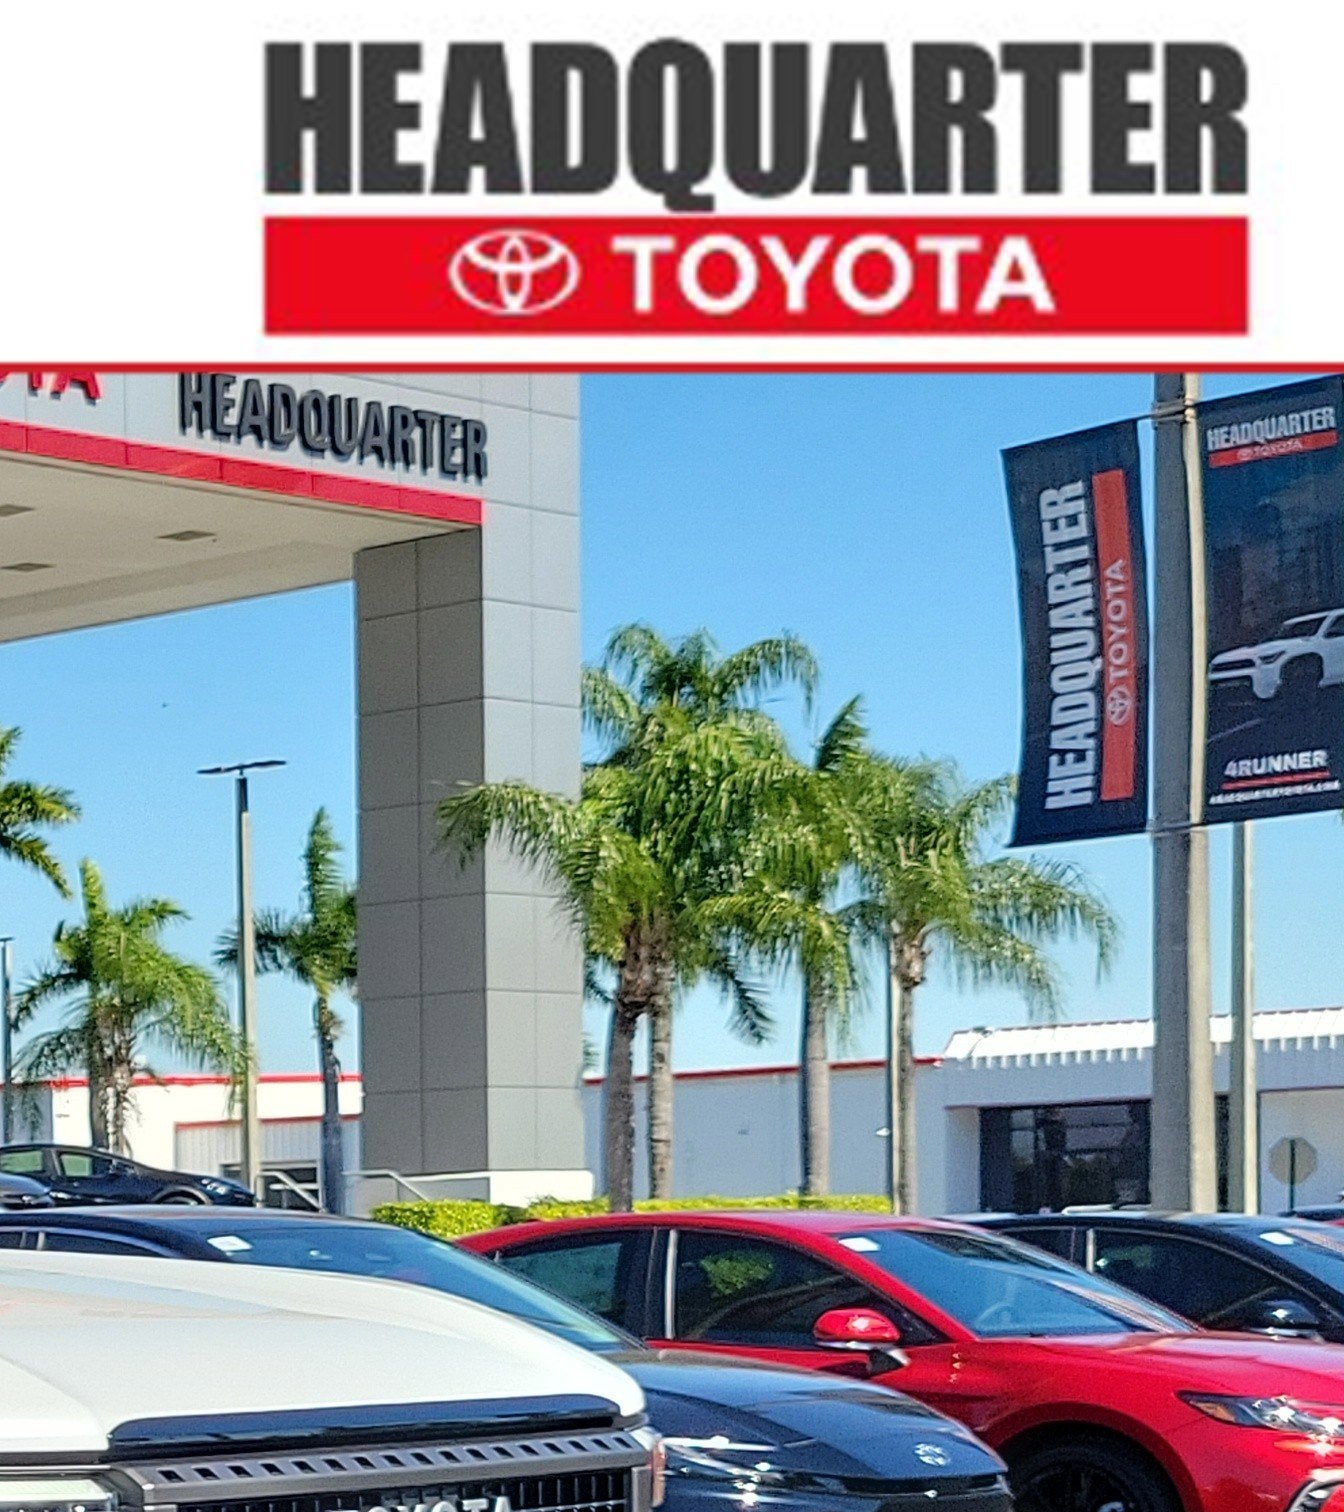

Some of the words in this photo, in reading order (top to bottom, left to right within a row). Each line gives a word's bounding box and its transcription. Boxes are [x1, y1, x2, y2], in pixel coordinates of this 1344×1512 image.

[178, 372, 489, 484] HEADQUARTER
[1206, 406, 1336, 450] HEADQUARTER
[1039, 479, 1103, 810] HEADQUARTER
[1106, 558, 1132, 688] TOYOTA
[1223, 748, 1329, 777] 4RUNNER
